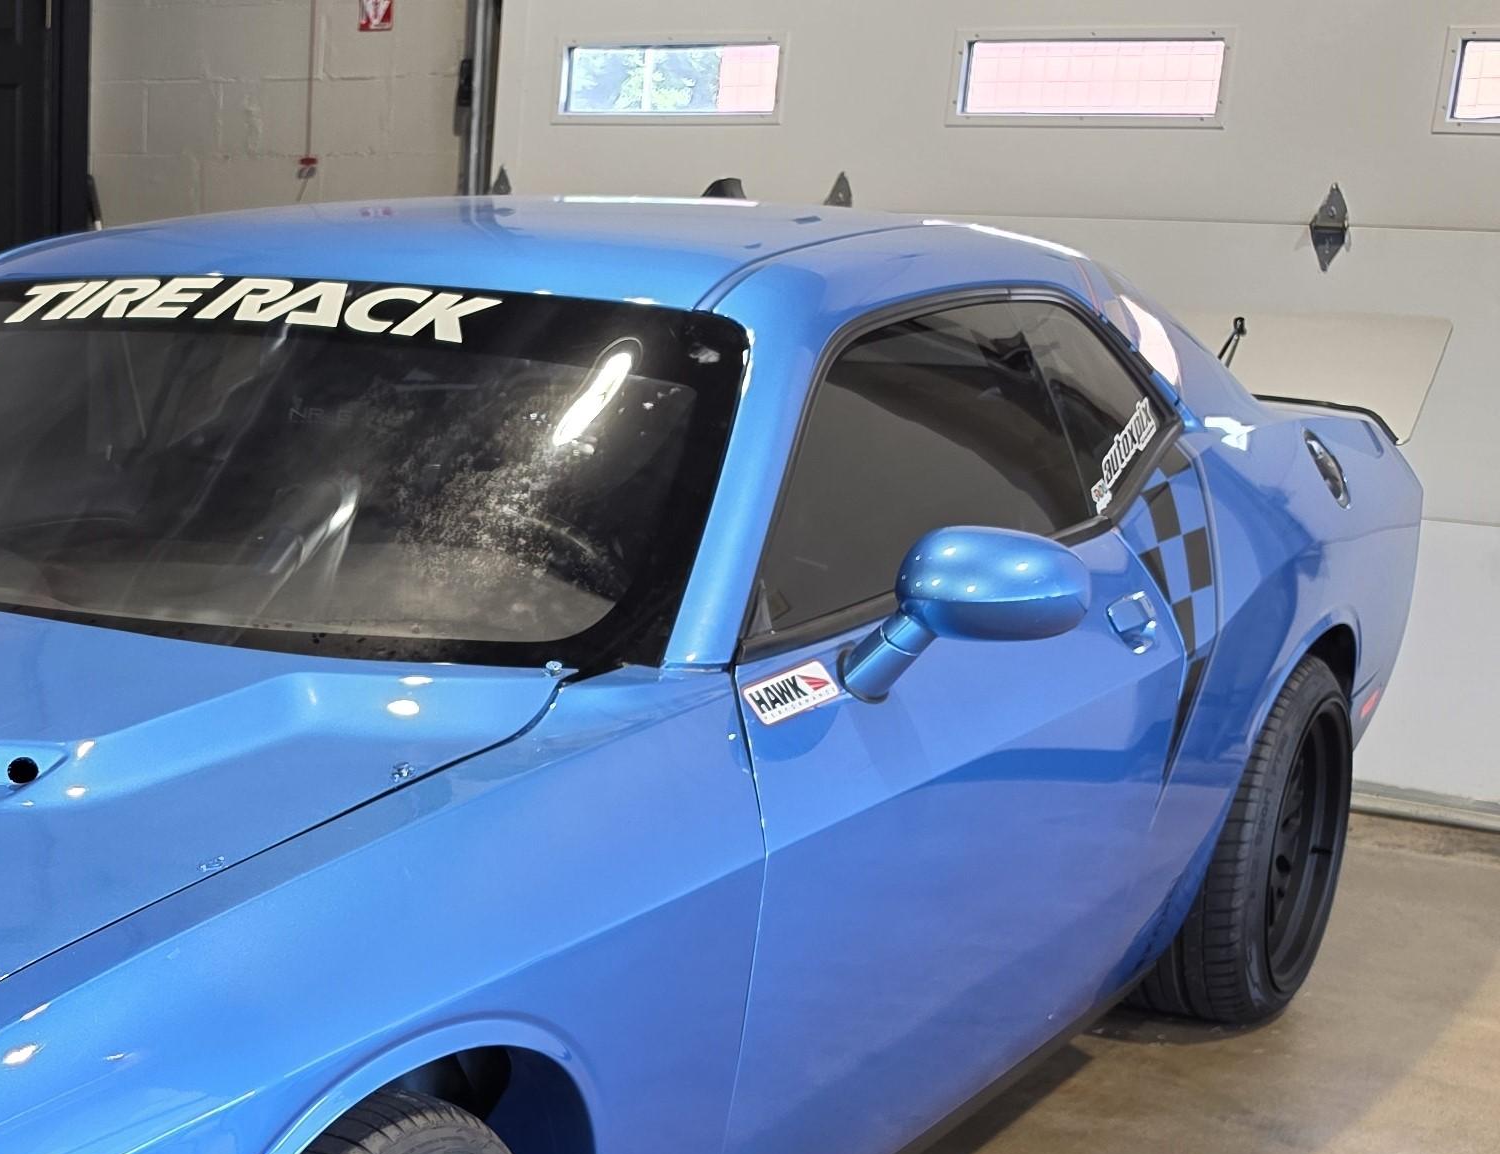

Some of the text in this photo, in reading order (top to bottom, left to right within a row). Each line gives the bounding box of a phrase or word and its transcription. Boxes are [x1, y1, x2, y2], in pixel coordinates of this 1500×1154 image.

[4, 277, 502, 344] TIRE RACK
[1103, 402, 1152, 485] autoxpix
[748, 675, 808, 714] HAWK
